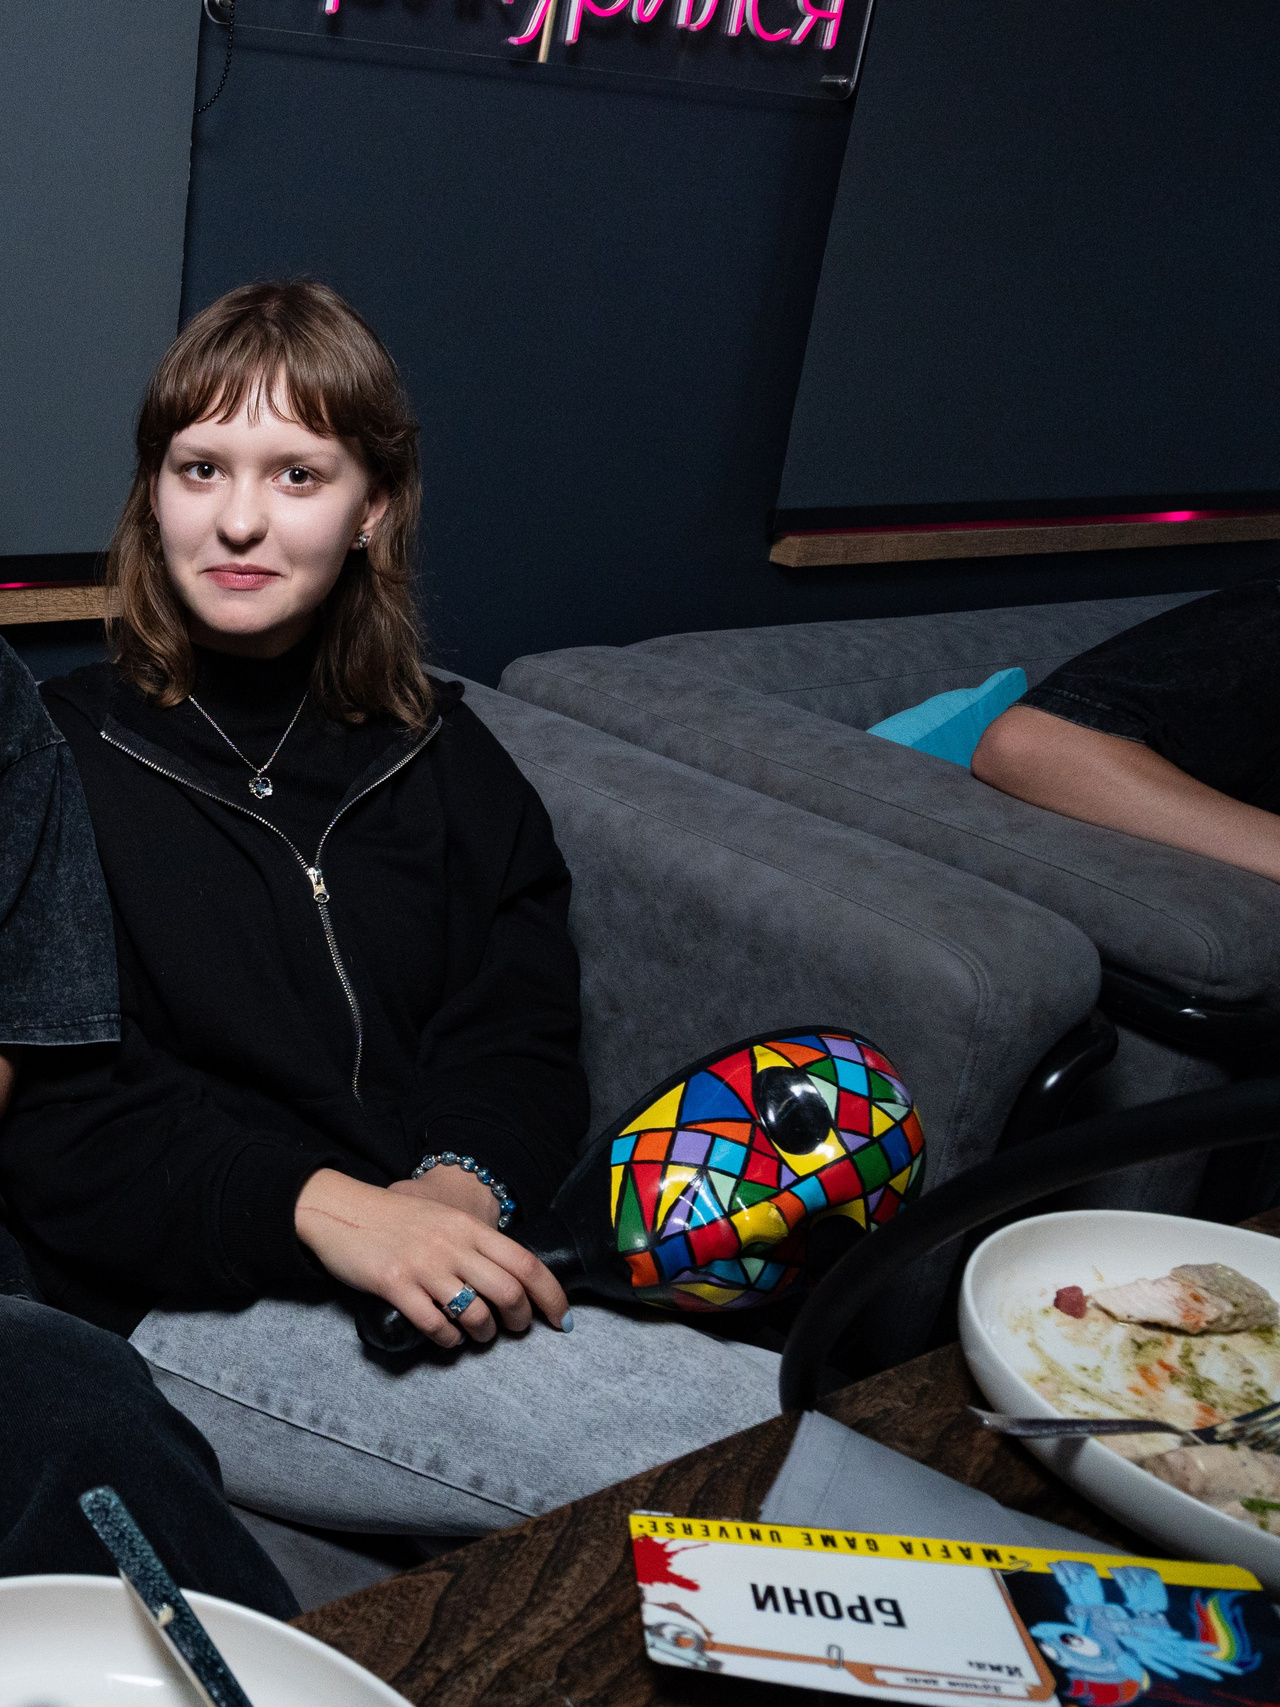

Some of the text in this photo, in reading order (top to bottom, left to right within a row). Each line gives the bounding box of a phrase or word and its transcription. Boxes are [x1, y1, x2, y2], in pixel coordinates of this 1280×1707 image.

[648, 1520, 783, 1545] UNIVERSE
[801, 1531, 881, 1552] GAME
[751, 1582, 908, 1630] БРОНИ
